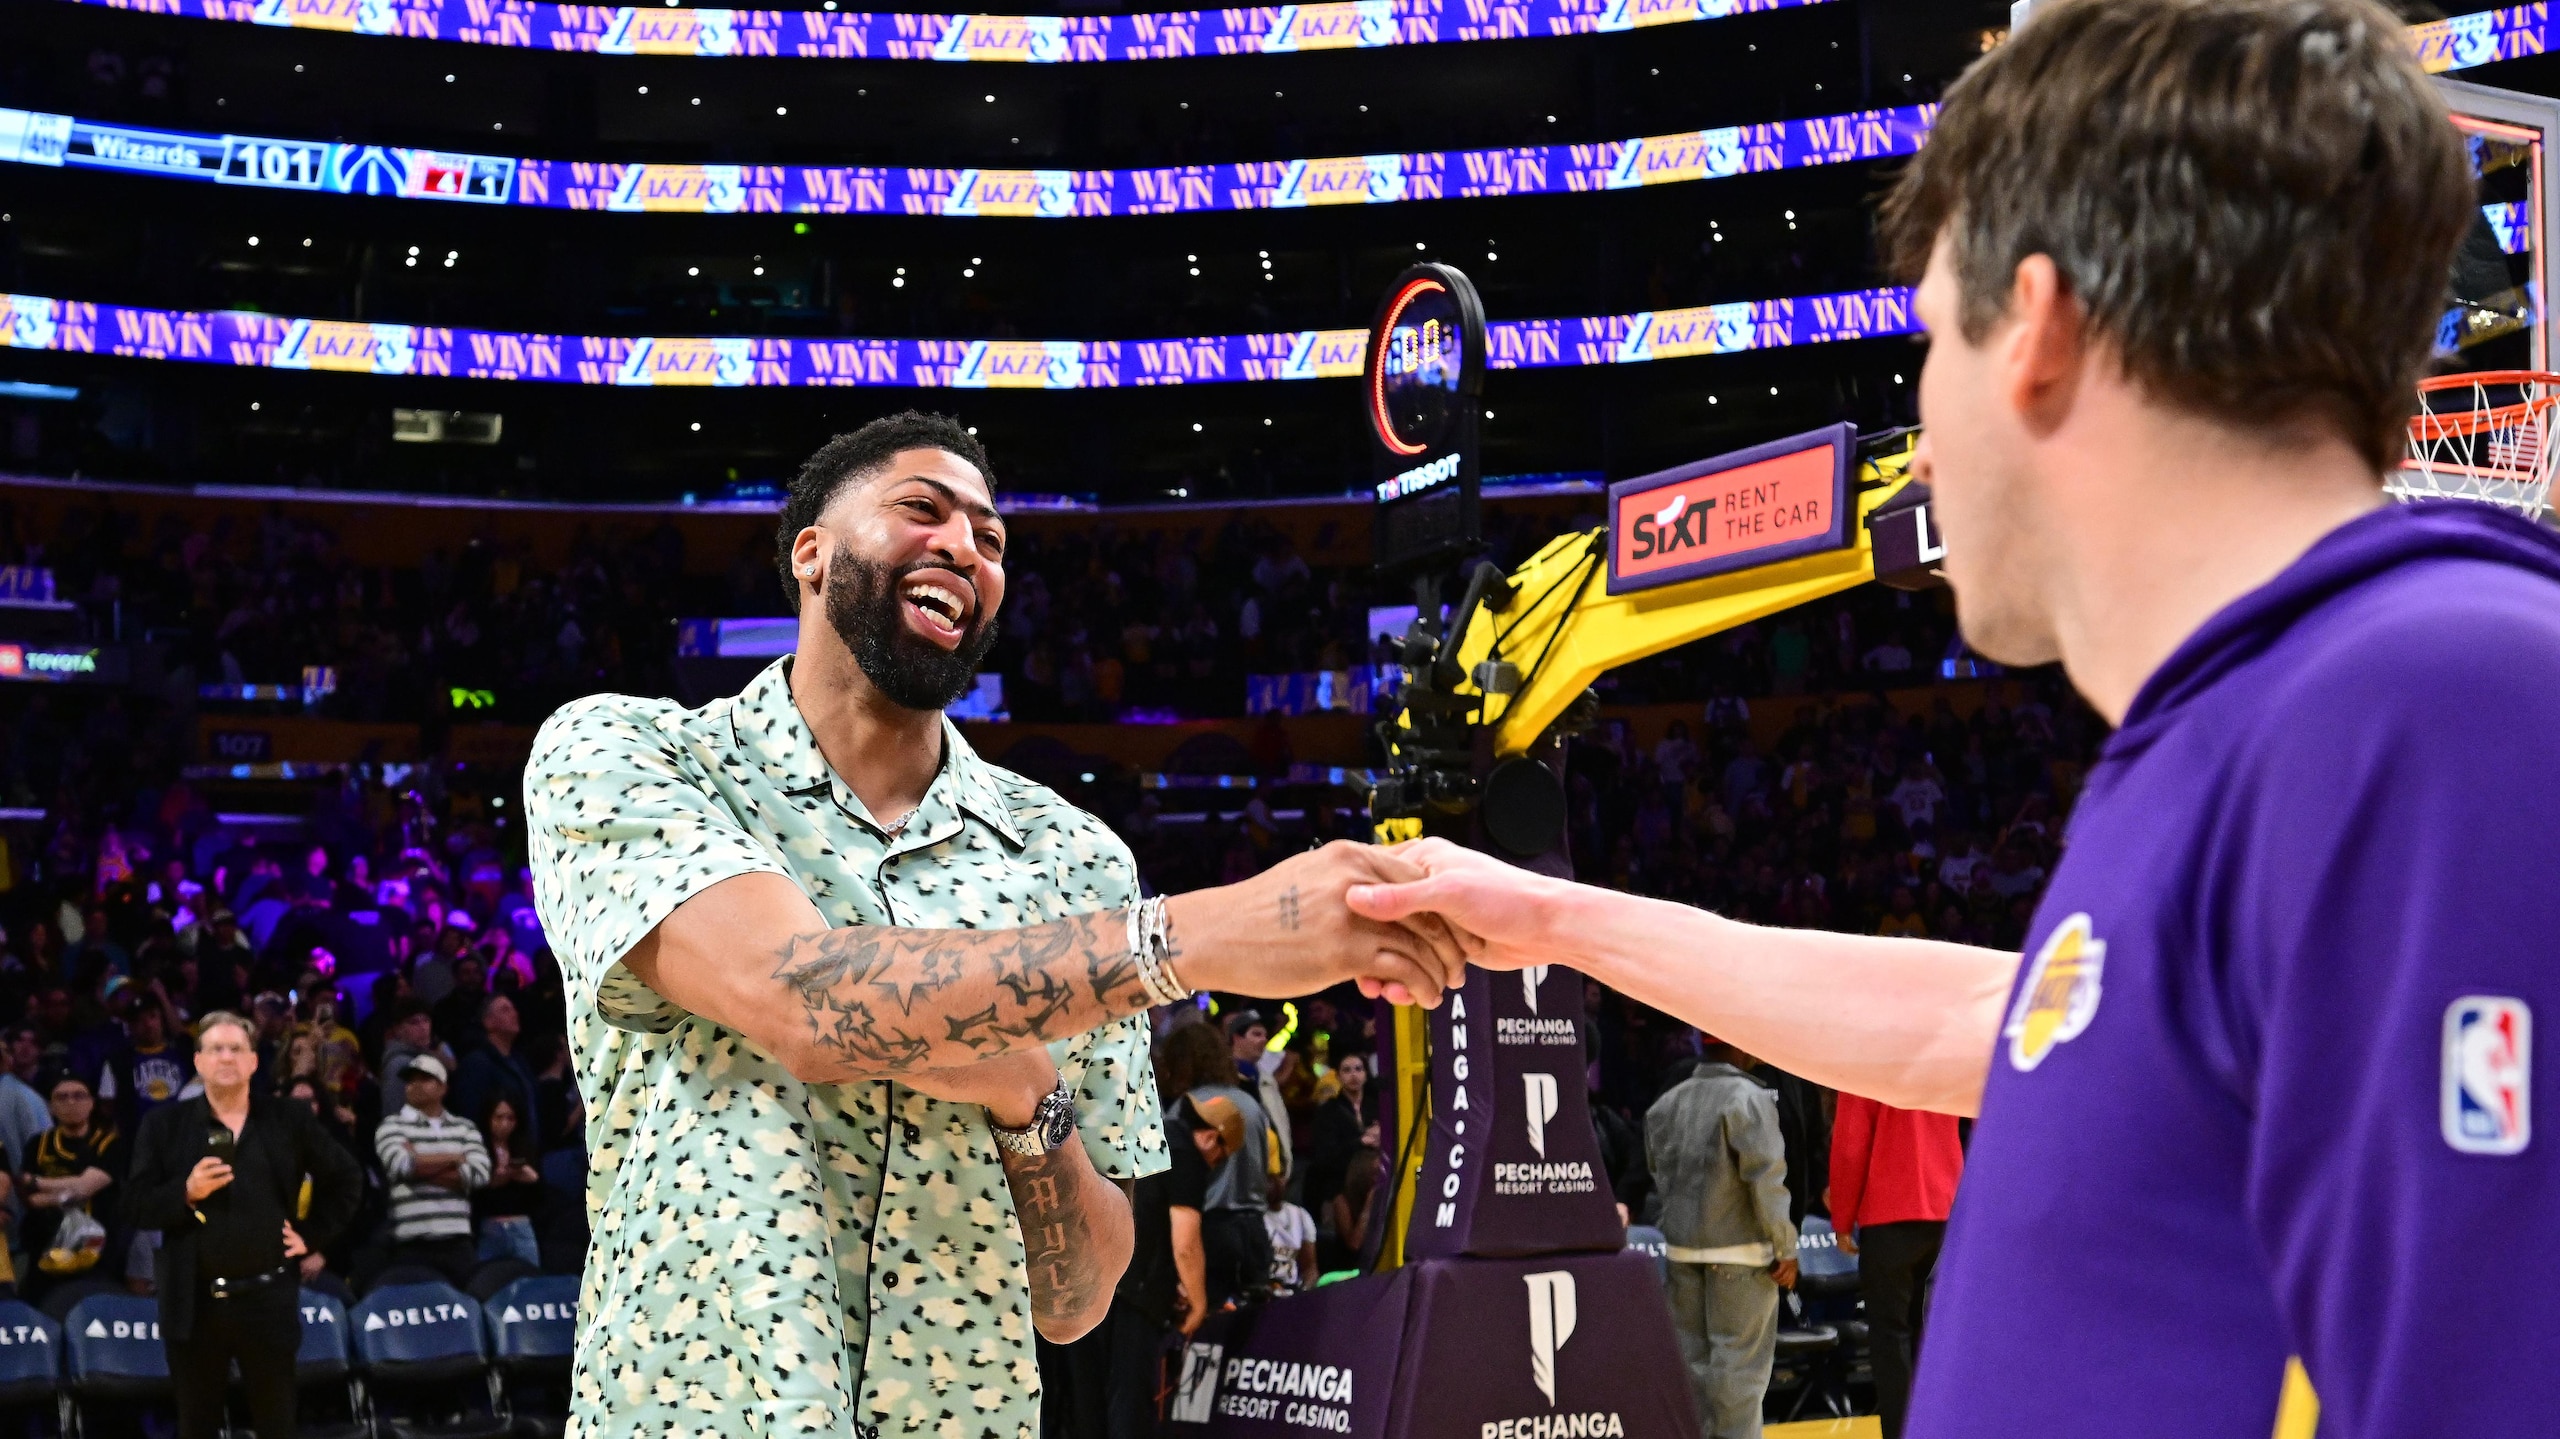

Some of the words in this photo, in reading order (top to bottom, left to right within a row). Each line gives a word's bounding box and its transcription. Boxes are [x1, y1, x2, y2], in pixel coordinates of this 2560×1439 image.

[91, 134, 201, 167] Wizards
[237, 143, 313, 183] 101
[436, 171, 458, 193] 4
[480, 175, 497, 198] 1
[1398, 452, 1461, 495] TISSOT
[1725, 481, 1781, 514] RENT
[1726, 516, 1764, 539] THE
[1774, 501, 1819, 527] CAR
[25, 652, 96, 672] TOYOTA
[1497, 1018, 1575, 1034] PECHANGA
[1498, 1034, 1536, 1045] RESORT
[1494, 1162, 1593, 1181] PECHANGA
[1495, 1182, 1542, 1195] RESORT
[388, 1303, 468, 1327] DELTA
[1223, 1357, 1353, 1405] PECHANGA
[1219, 1393, 1280, 1420] RESORT
[1482, 1411, 1624, 1439] PECHANGA
